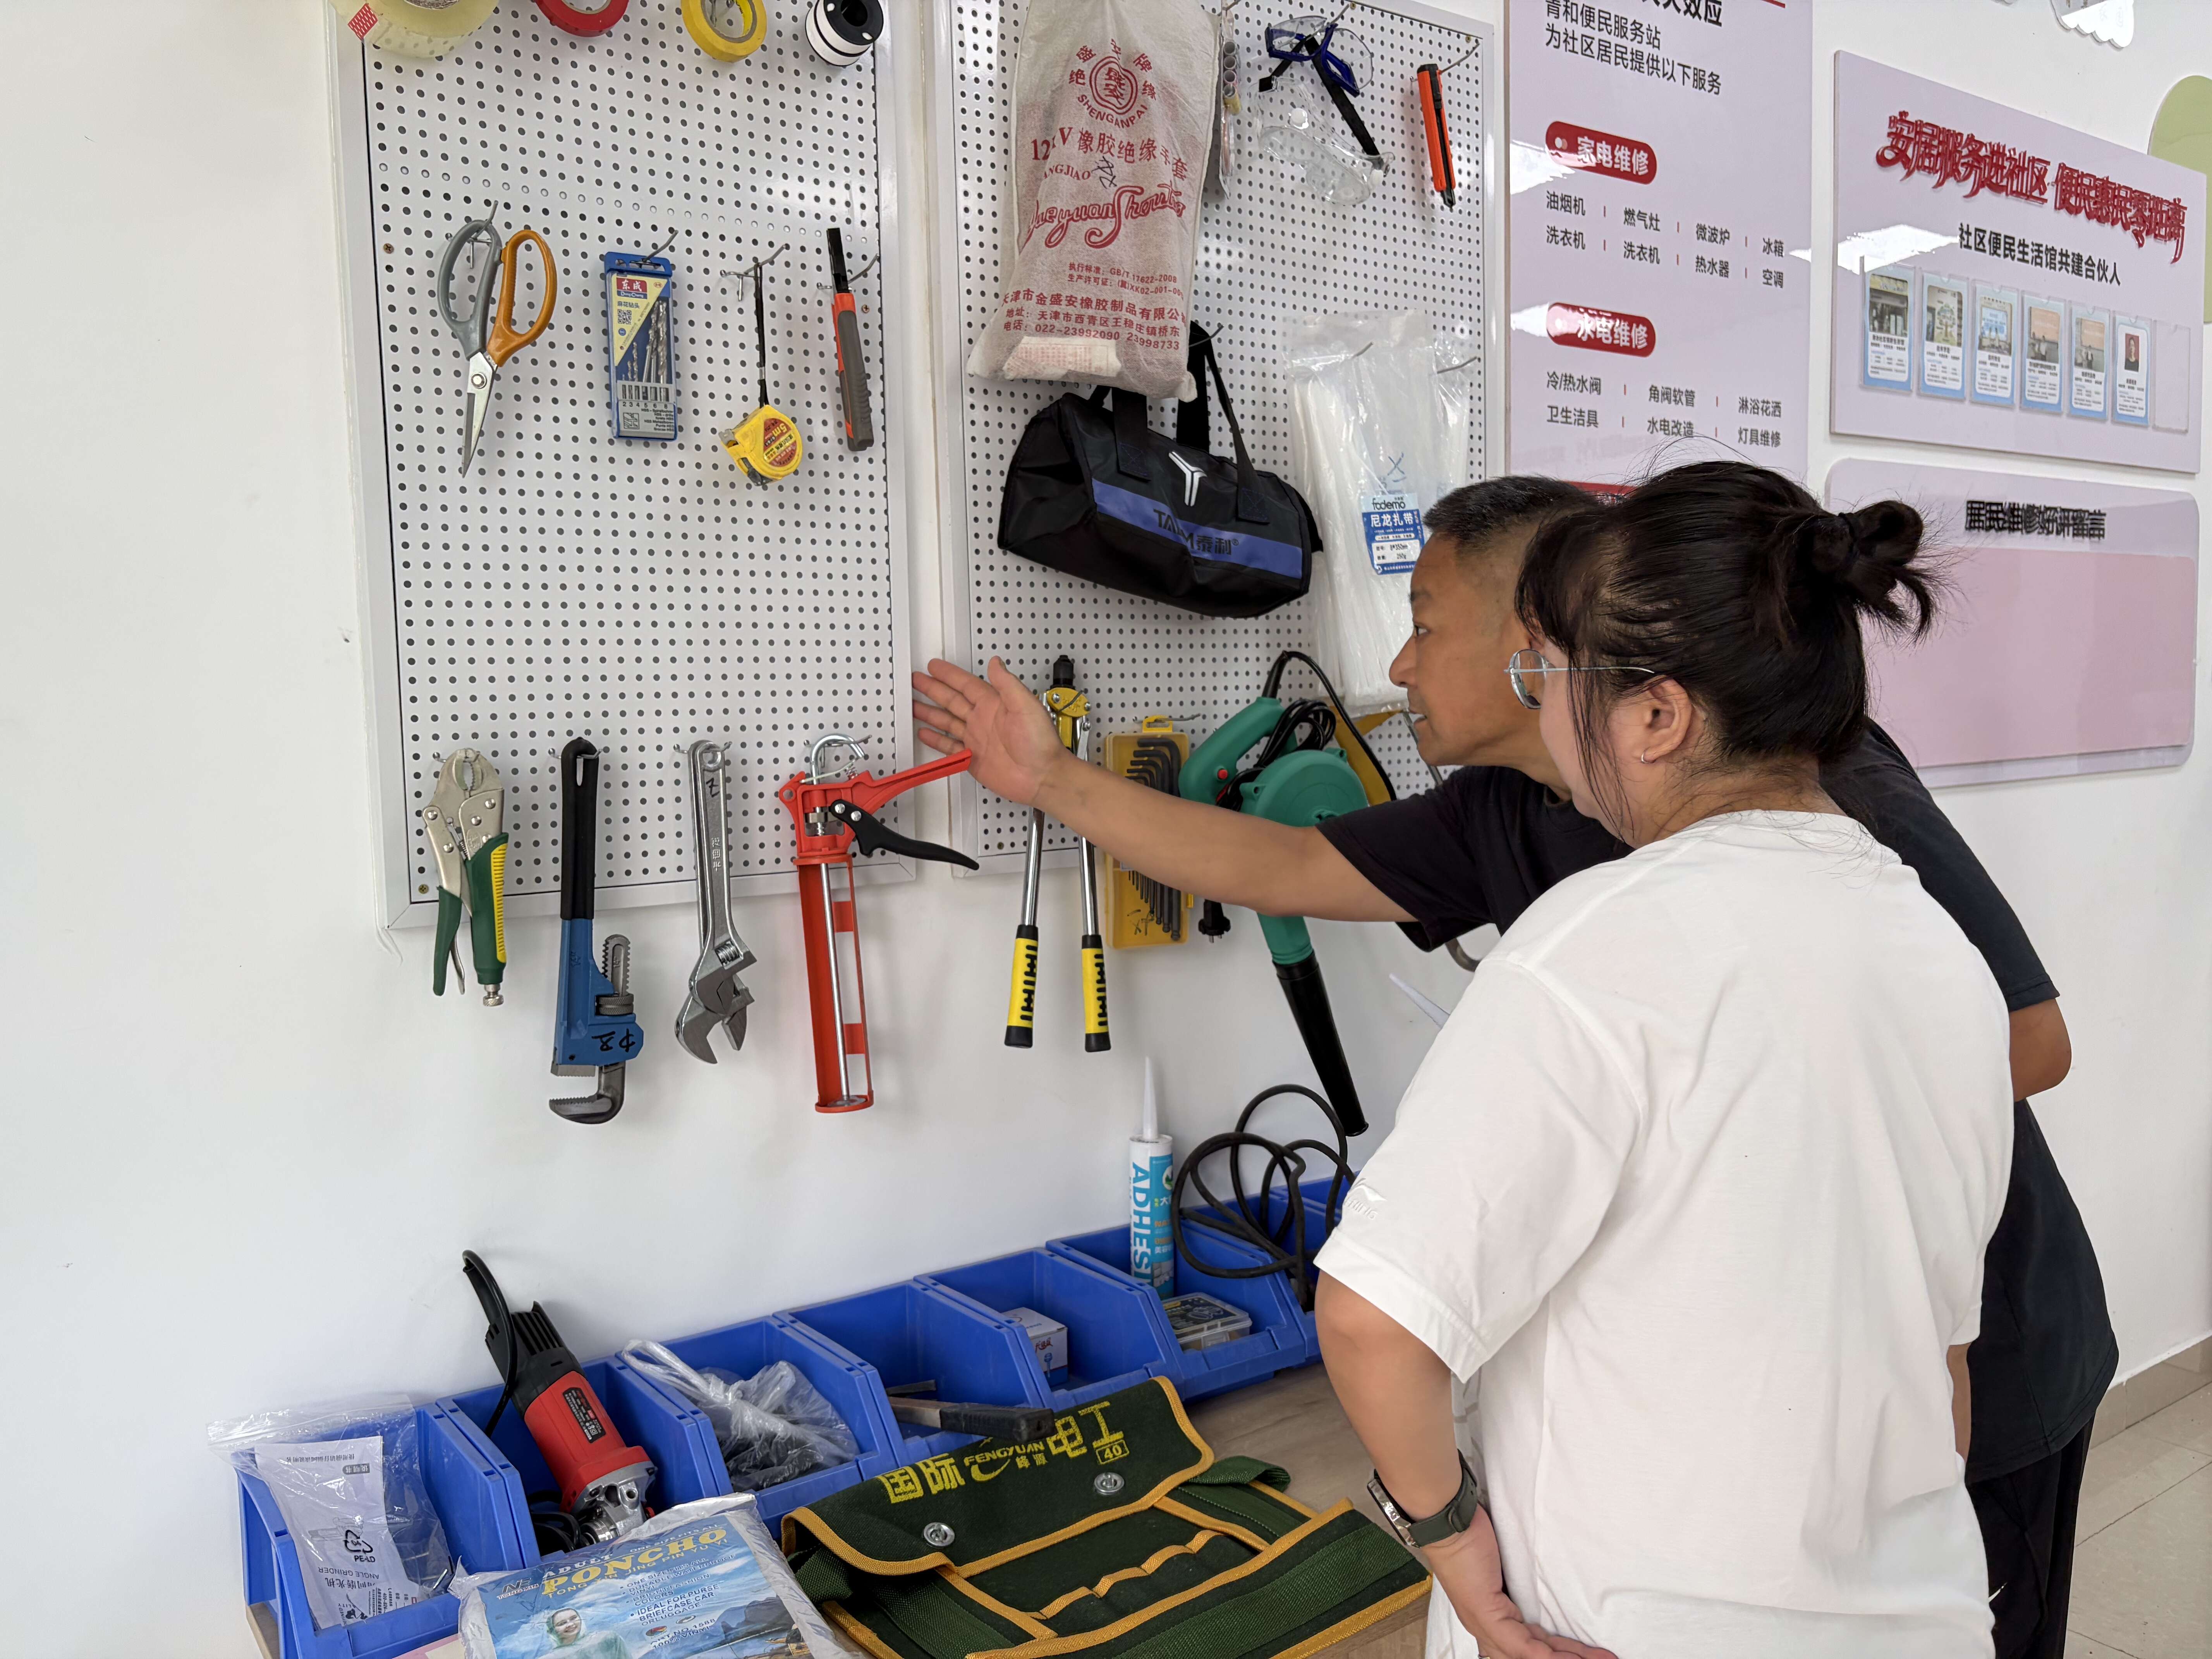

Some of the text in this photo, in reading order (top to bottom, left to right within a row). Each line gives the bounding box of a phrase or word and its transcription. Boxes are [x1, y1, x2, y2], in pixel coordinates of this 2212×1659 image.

[1546, 0, 1661, 50] 青和便民服务站
[1642, 0, 1722, 27] 效应
[1546, 23, 1721, 96] 为社区居民提供以下服务
[1078, 94, 1147, 129] SHENGANPAI
[1043, 165, 1091, 180] ANGJIAO
[1577, 136, 1649, 176] 家电维修
[1876, 110, 2188, 264] 安居服务进社区 便民惠民零距离
[1546, 191, 1784, 258] 油烟机 燃气灶 微波炉 冰箱
[1546, 225, 1784, 289] 洗衣机 洗衣机 热水器 空调
[1958, 224, 2122, 286] 社区便民生活馆共建合伙人
[622, 279, 642, 292] 东成
[1132, 274, 1177, 283] 17622-2008
[1036, 325, 1120, 340] 022-23992090
[1127, 333, 1180, 350] 23998733
[1577, 313, 1648, 350] 水电维修
[1546, 372, 1781, 419] 冷/热水阀 角阀软管 淋浴花洒
[1547, 405, 1781, 448] 卫生洁具 水电改造 灯具维修
[1370, 512, 1413, 527] 尼龙扎带
[1965, 500, 2106, 540] 居民维修好评留言
[1132, 1162, 1151, 1279] ADHESI
[1046, 1401, 1124, 1458] 电工
[964, 1441, 1044, 1466] FENGYUAN
[1104, 1445, 1122, 1459] 40
[318, 1567, 379, 1579] ANGLE GRINDER
[542, 1529, 726, 1594] PONCHO
[543, 1554, 612, 1578] ADULT
[546, 1583, 587, 1598] TONG
[625, 1562, 656, 1575] JING
[662, 1552, 684, 1562] PIN
[627, 1578, 646, 1587] ONE
[648, 1570, 668, 1579] SIZE
[629, 1575, 673, 1593] DURABLE
[635, 1590, 674, 1606] COLORS
[637, 1584, 719, 1615] IDEAL FOR PURSE
